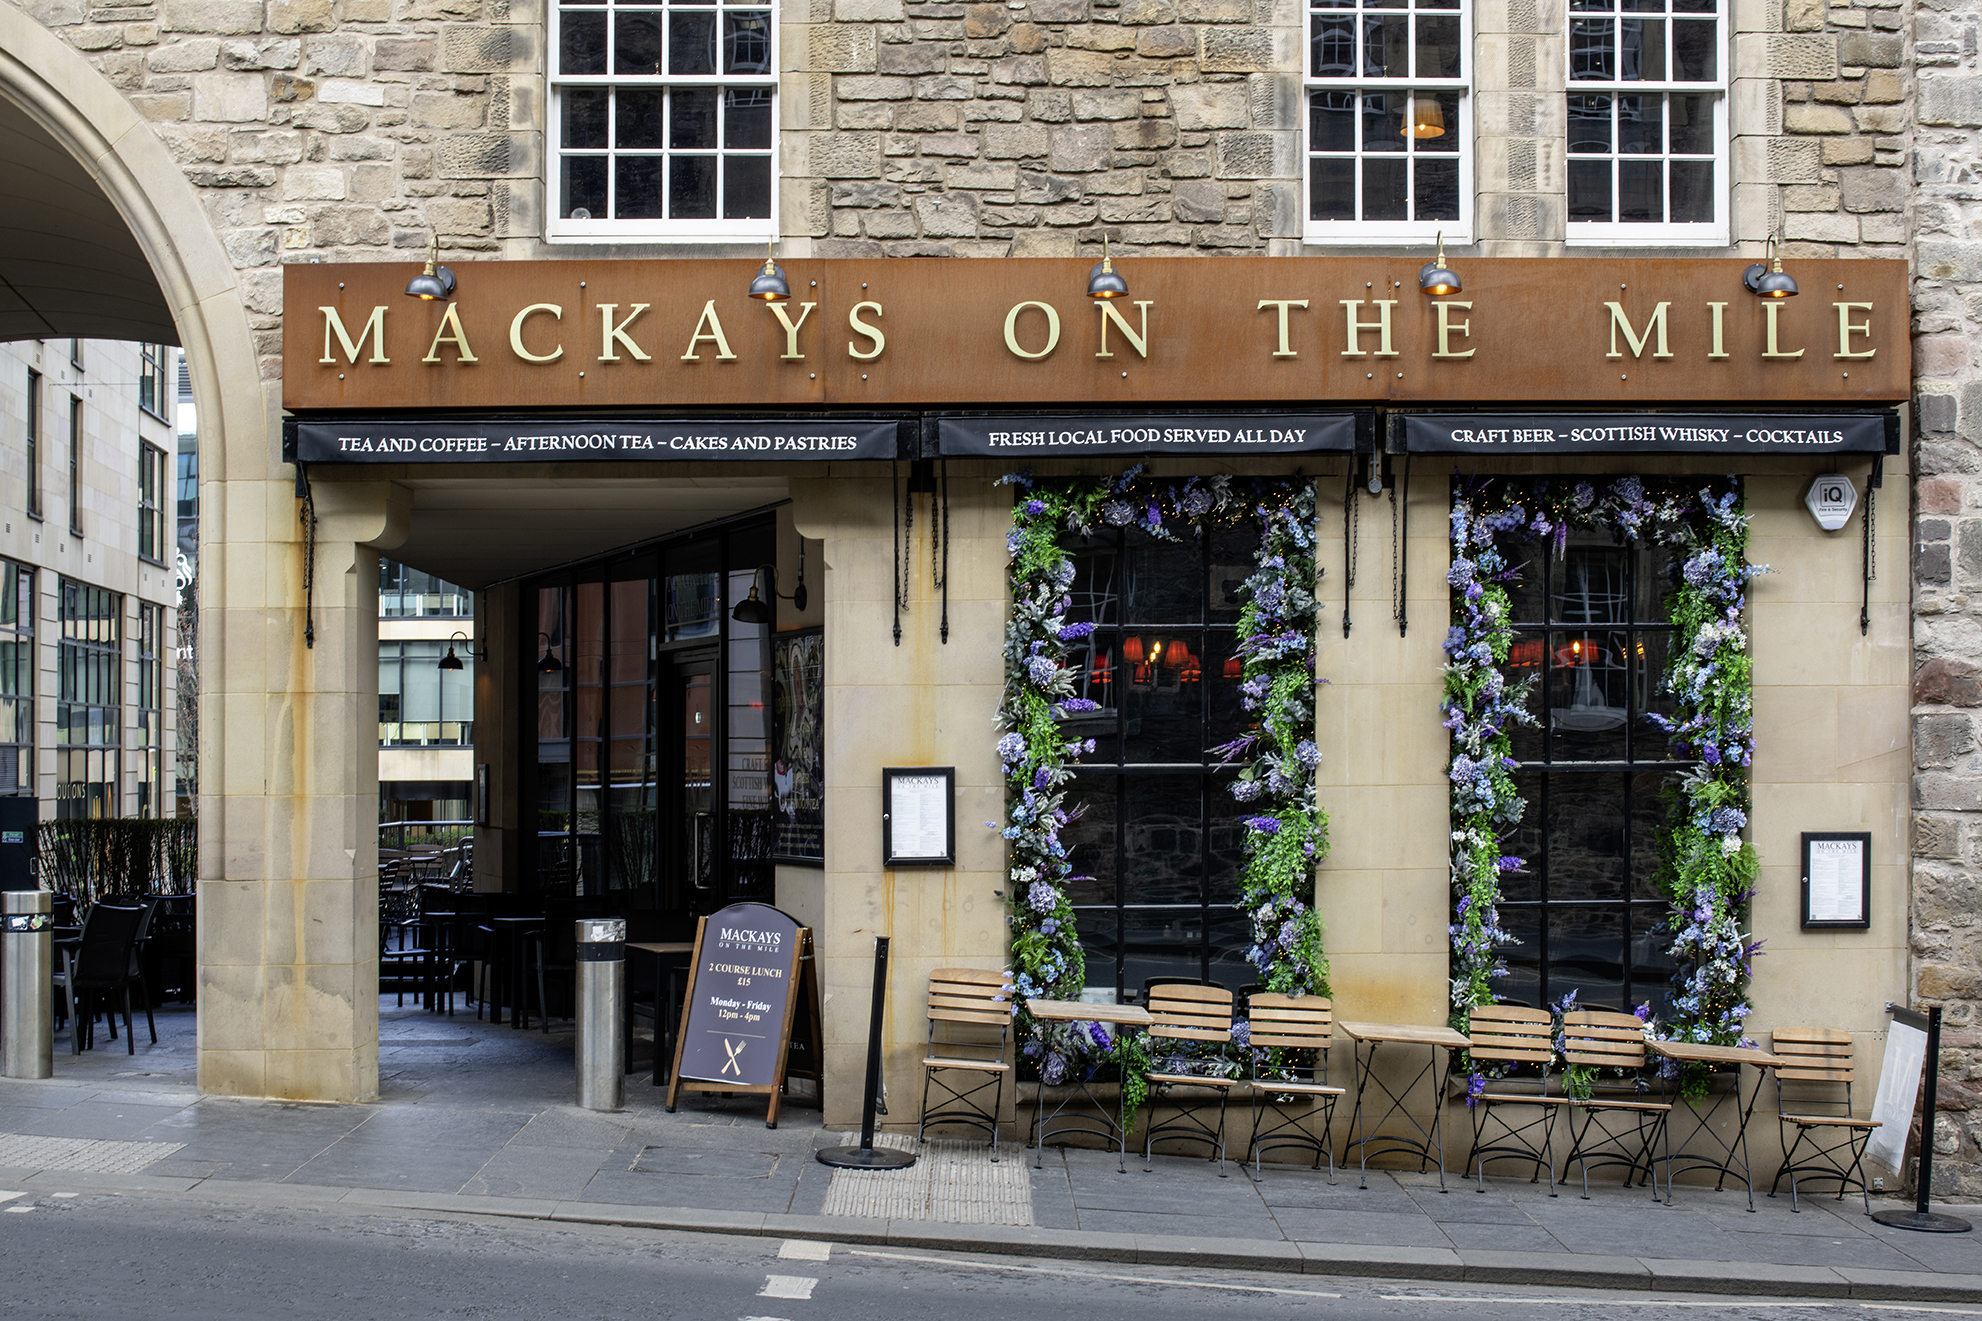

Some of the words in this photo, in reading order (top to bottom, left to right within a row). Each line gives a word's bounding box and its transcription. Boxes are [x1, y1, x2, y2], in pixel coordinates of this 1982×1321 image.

[318, 299, 886, 364] MACKAYS
[1003, 300, 1154, 359] ON
[1257, 299, 1477, 357] THE
[1604, 300, 1877, 358] MILE
[988, 431, 1045, 447] FRESH
[1048, 430, 1108, 446] LOCAL
[1111, 428, 1161, 444] FOOD
[1163, 428, 1231, 444] SERVED
[1233, 428, 1267, 444] ALL
[1269, 428, 1307, 444] DAY
[1450, 428, 1509, 444] CRAFT
[1511, 428, 1557, 443] BEER
[1570, 426, 1657, 442] SCOTTISH
[1659, 426, 1730, 443] WHISKY
[1745, 428, 1844, 444] COCKTAILS
[338, 437, 374, 452] TEA
[375, 437, 417, 452] AND
[419, 437, 488, 453] COFFEE
[503, 434, 618, 452] AFTERNOON
[619, 434, 655, 450] TEA
[669, 435, 729, 451] CAKES
[730, 435, 772, 451] AND
[773, 435, 858, 451] PASTRIES
[1823, 486, 1843, 503] iQ
[742, 757, 763, 771] CRAFT
[732, 776, 763, 790] SCOTTISH
[897, 776, 939, 785] MACKAYS
[1817, 842, 1857, 850] MACKAYS
[719, 927, 782, 945] MACKAYS
[735, 943, 752, 951] THE
[757, 945, 780, 953] MILE
[708, 962, 714, 972] 2
[715, 963, 751, 975] COURSE
[751, 966, 783, 978] LUNCH
[737, 977, 751, 987] £15
[710, 996, 741, 1010] Monday
[746, 1000, 772, 1013] Friday
[718, 1008, 739, 1021] 12pm
[744, 1011, 761, 1023] 4pm
